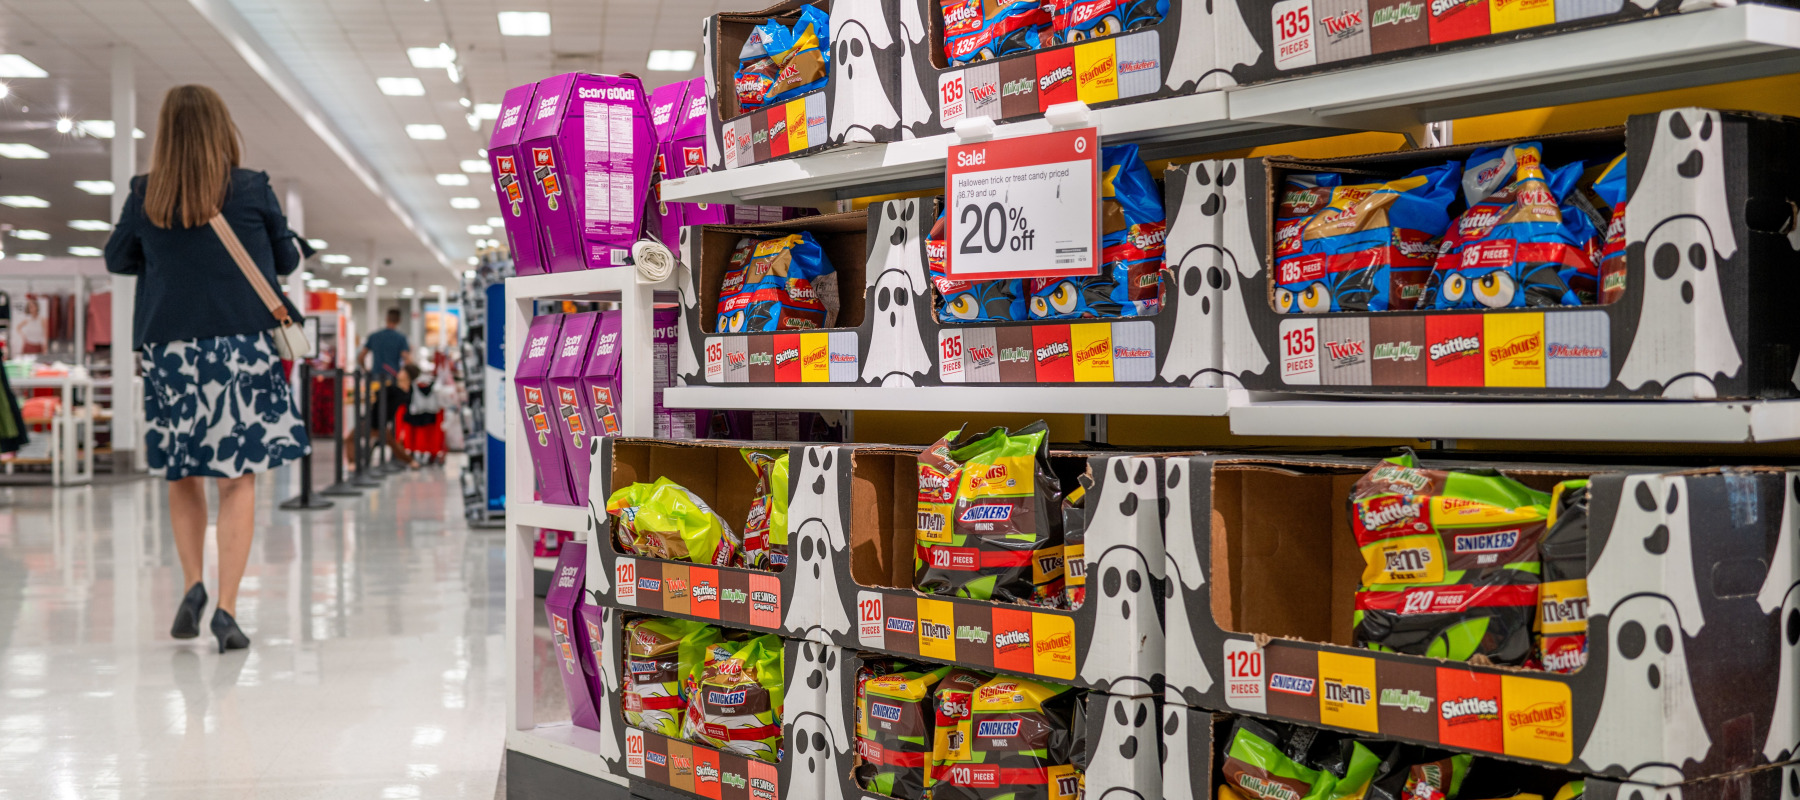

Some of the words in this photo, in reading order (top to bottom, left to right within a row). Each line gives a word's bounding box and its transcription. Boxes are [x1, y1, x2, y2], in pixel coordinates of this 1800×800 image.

[1074, 4, 1095, 23] 135
[1276, 6, 1310, 40] 135
[1320, 10, 1362, 36] Twix
[956, 37, 976, 54] 135
[1280, 39, 1309, 57] PIECES
[1080, 57, 1113, 84] Starburst
[1125, 60, 1156, 71] Musketeers
[1040, 66, 1072, 90] Skittles
[578, 87, 606, 99] Scary
[941, 77, 964, 104] 135
[970, 82, 996, 103] Twix
[541, 95, 560, 106] Scary
[504, 105, 521, 118] Scary
[654, 102, 673, 117] Scary
[944, 104, 962, 118] PIECES
[770, 120, 786, 140] Skittles
[724, 128, 735, 150] 135
[738, 132, 750, 148] Twix
[958, 149, 985, 167] Sale!
[959, 178, 988, 187] Halloween
[991, 176, 1003, 184] trick
[1029, 171, 1047, 181] candy
[1049, 168, 1069, 179] priced
[976, 189, 986, 197] and
[989, 189, 996, 197] up
[1532, 208, 1556, 216] minis
[960, 202, 1006, 254] 20
[1010, 229, 1034, 251] off
[1400, 241, 1438, 255] Skittles
[1462, 246, 1481, 268] 135
[1483, 249, 1508, 259] PIECES
[1282, 261, 1300, 282] 135
[1303, 263, 1321, 273] PIECES
[532, 336, 548, 348] Scary
[565, 335, 582, 346] Scary
[600, 332, 617, 344] Scary
[1283, 327, 1315, 356] 135
[706, 343, 722, 362] 135
[941, 335, 962, 359] 135
[968, 344, 994, 363] Twix
[1036, 342, 1069, 362] Skittles
[1076, 340, 1109, 363] Starburst
[1120, 348, 1152, 358] Musketeers
[1325, 338, 1364, 361] Twix
[1430, 336, 1480, 361] Skittles
[1489, 334, 1540, 363] Starburst
[1557, 346, 1603, 358] Musketeers
[727, 350, 745, 366] Twix
[776, 348, 798, 365] Skittles
[804, 346, 826, 365] Starburst
[708, 364, 721, 374] PIECES
[943, 362, 961, 372] PIECES
[1287, 359, 1313, 372] PIECES
[1389, 484, 1413, 495] minis
[963, 506, 1010, 519] SNICKERS
[1365, 503, 1420, 531] Skittles
[1458, 532, 1516, 550] SNICKERS
[933, 550, 949, 566] 120
[953, 556, 973, 564] PIECES
[1477, 554, 1498, 564] MINIS
[562, 566, 578, 576] Scary
[617, 564, 634, 583] 120
[1390, 572, 1415, 580] fun
[619, 586, 633, 594] PIECES
[639, 579, 659, 590] SNICKERS
[666, 578, 687, 592] Twix
[693, 586, 717, 597] Skittles
[1404, 591, 1434, 612] 120
[1435, 595, 1463, 605] PIECES
[859, 599, 881, 621] 120
[862, 626, 880, 634] PIECES
[888, 618, 914, 632] SNICKERS
[996, 631, 1030, 648] Skittles
[1036, 634, 1071, 653] Starburst
[1227, 651, 1261, 677] 120
[980, 683, 1018, 699] Starburst
[1231, 684, 1259, 694] PIECES
[1272, 675, 1312, 692] SNICKERS
[710, 691, 745, 705] SNICKERS
[873, 704, 900, 720] SNICKERS
[1441, 698, 1498, 719] Skittles
[1509, 704, 1565, 727] Starburst
[979, 721, 1018, 735] SNICKERS
[627, 735, 642, 754] 120
[628, 757, 642, 765] PIECES
[647, 752, 666, 764] SNICKERS
[671, 754, 691, 769] Twix
[869, 749, 880, 758] PIECES
[696, 766, 718, 777] Skittles
[952, 768, 970, 784] 120
